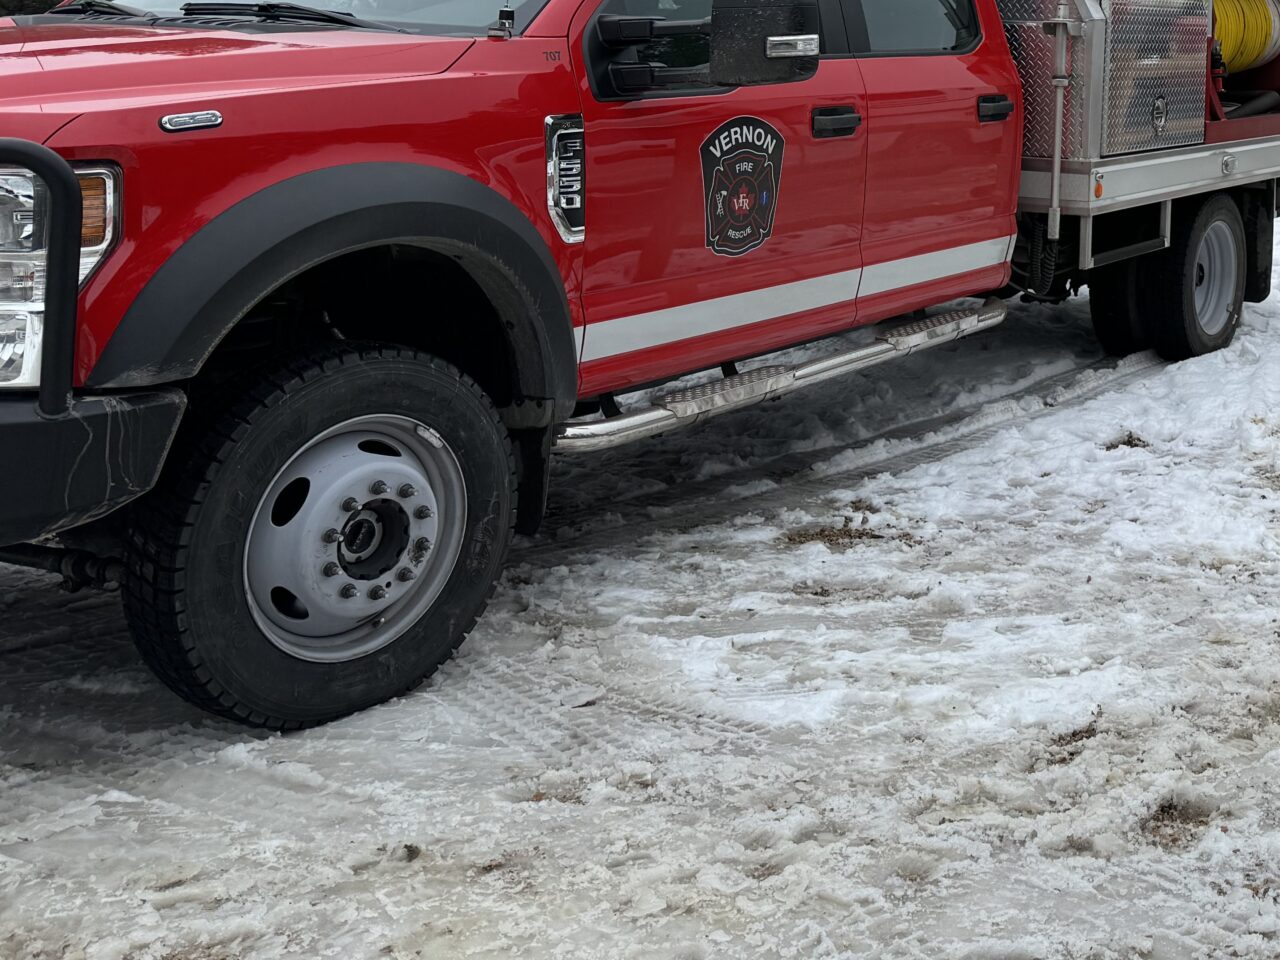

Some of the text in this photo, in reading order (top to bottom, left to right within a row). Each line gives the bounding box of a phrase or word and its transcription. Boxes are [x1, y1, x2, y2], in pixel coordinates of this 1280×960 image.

[542, 51, 561, 61] 707
[709, 126, 776, 158] VERNON
[559, 139, 583, 209] F550
[735, 161, 754, 174] FIRE
[727, 226, 752, 239] RESCUE
